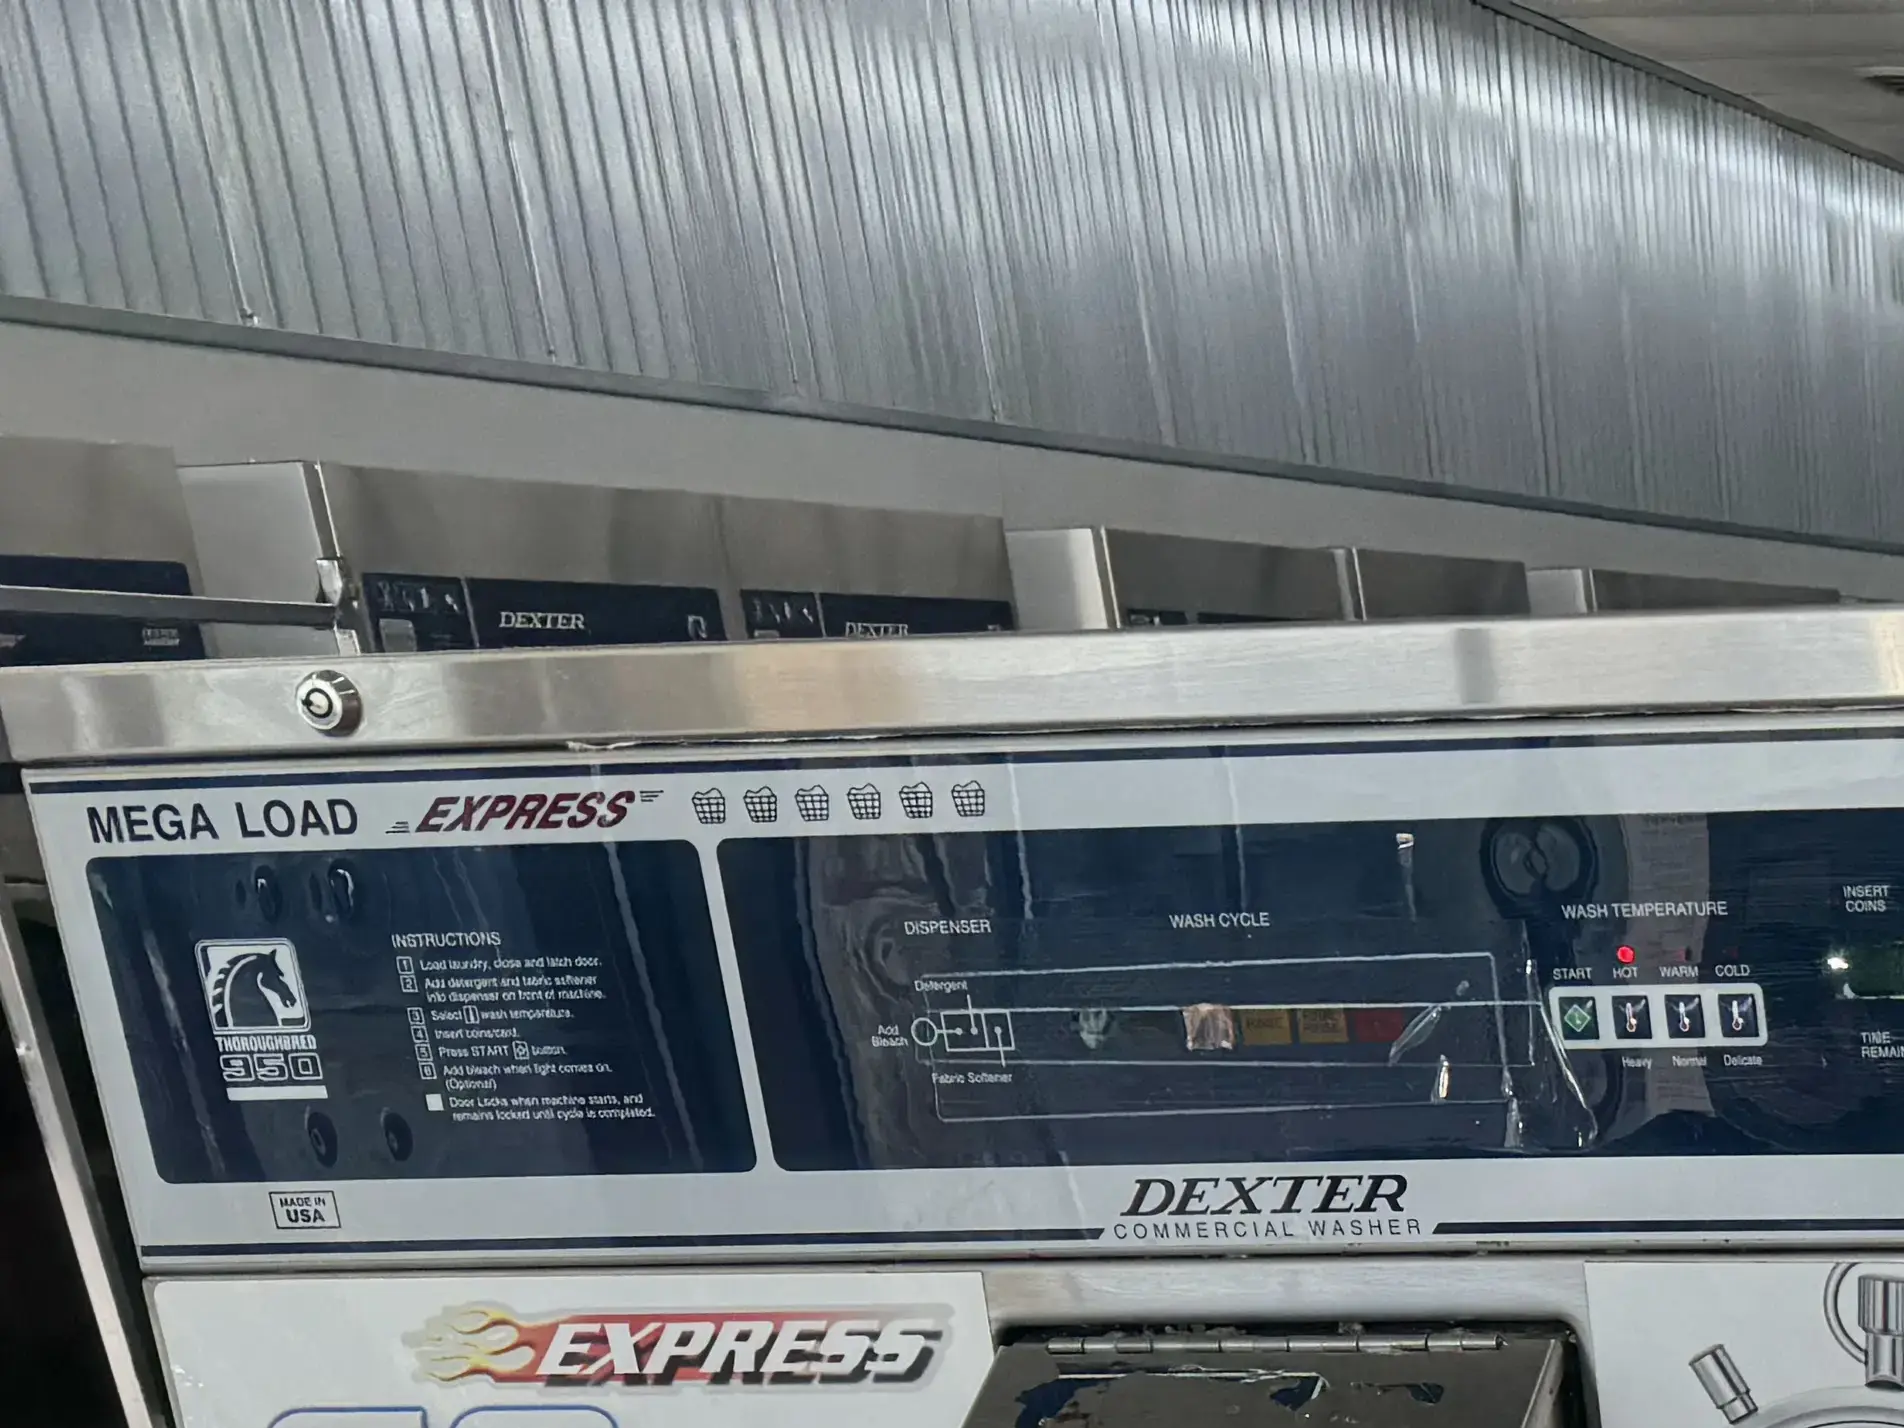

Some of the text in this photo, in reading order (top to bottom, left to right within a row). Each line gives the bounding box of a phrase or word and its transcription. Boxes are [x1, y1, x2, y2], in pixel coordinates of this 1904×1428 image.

[498, 611, 586, 631] DEXTER
[87, 791, 635, 843] MEGA LOAD EXPRESS
[220, 1052, 323, 1081] 950
[1120, 1175, 1407, 1216] DEXTER
[1114, 1219, 1420, 1239] COMMERCIAL WASHER
[535, 1318, 932, 1376] EXPRESS
